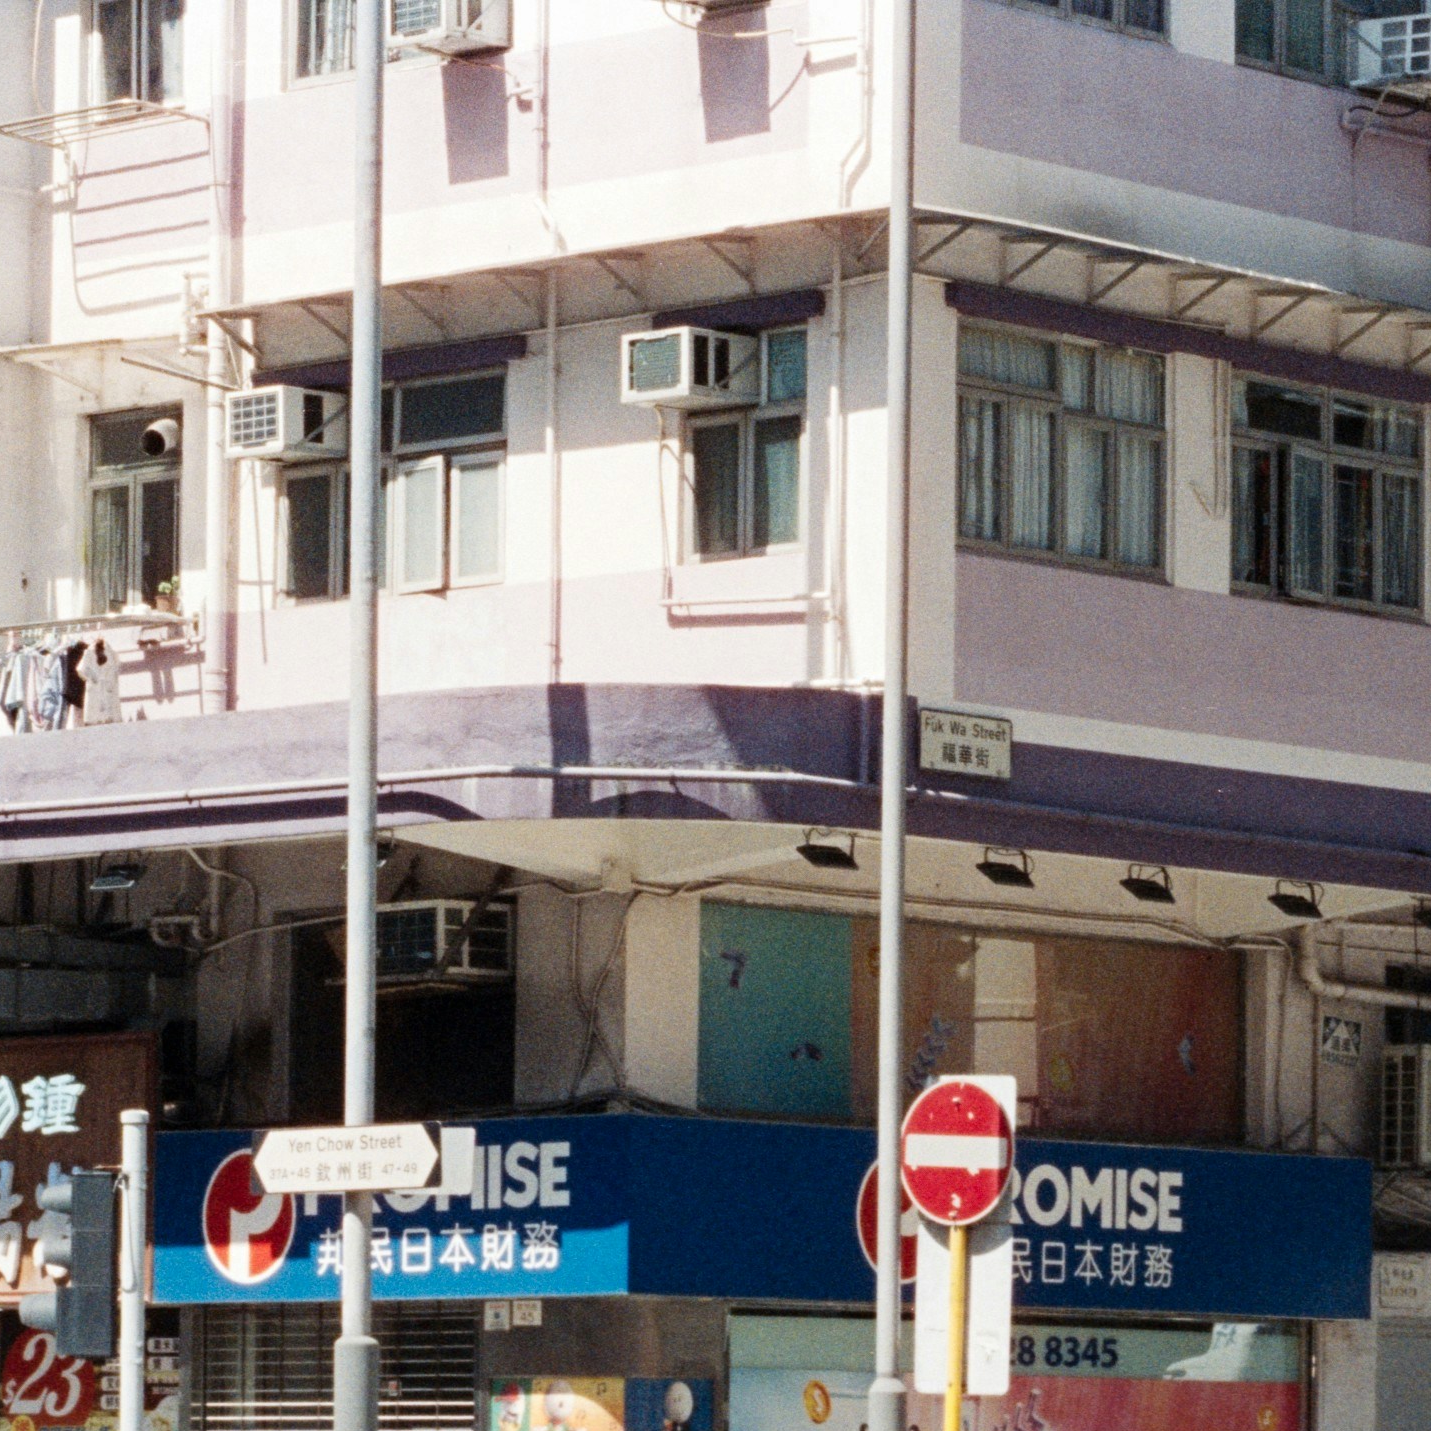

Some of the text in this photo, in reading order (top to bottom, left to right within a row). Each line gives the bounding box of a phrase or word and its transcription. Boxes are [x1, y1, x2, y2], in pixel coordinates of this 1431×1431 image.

[924, 716, 1007, 742] Fuk Wa Street
[287, 1133, 403, 1154] Yen Chow Street
[1044, 1336, 1119, 1368] 8345
